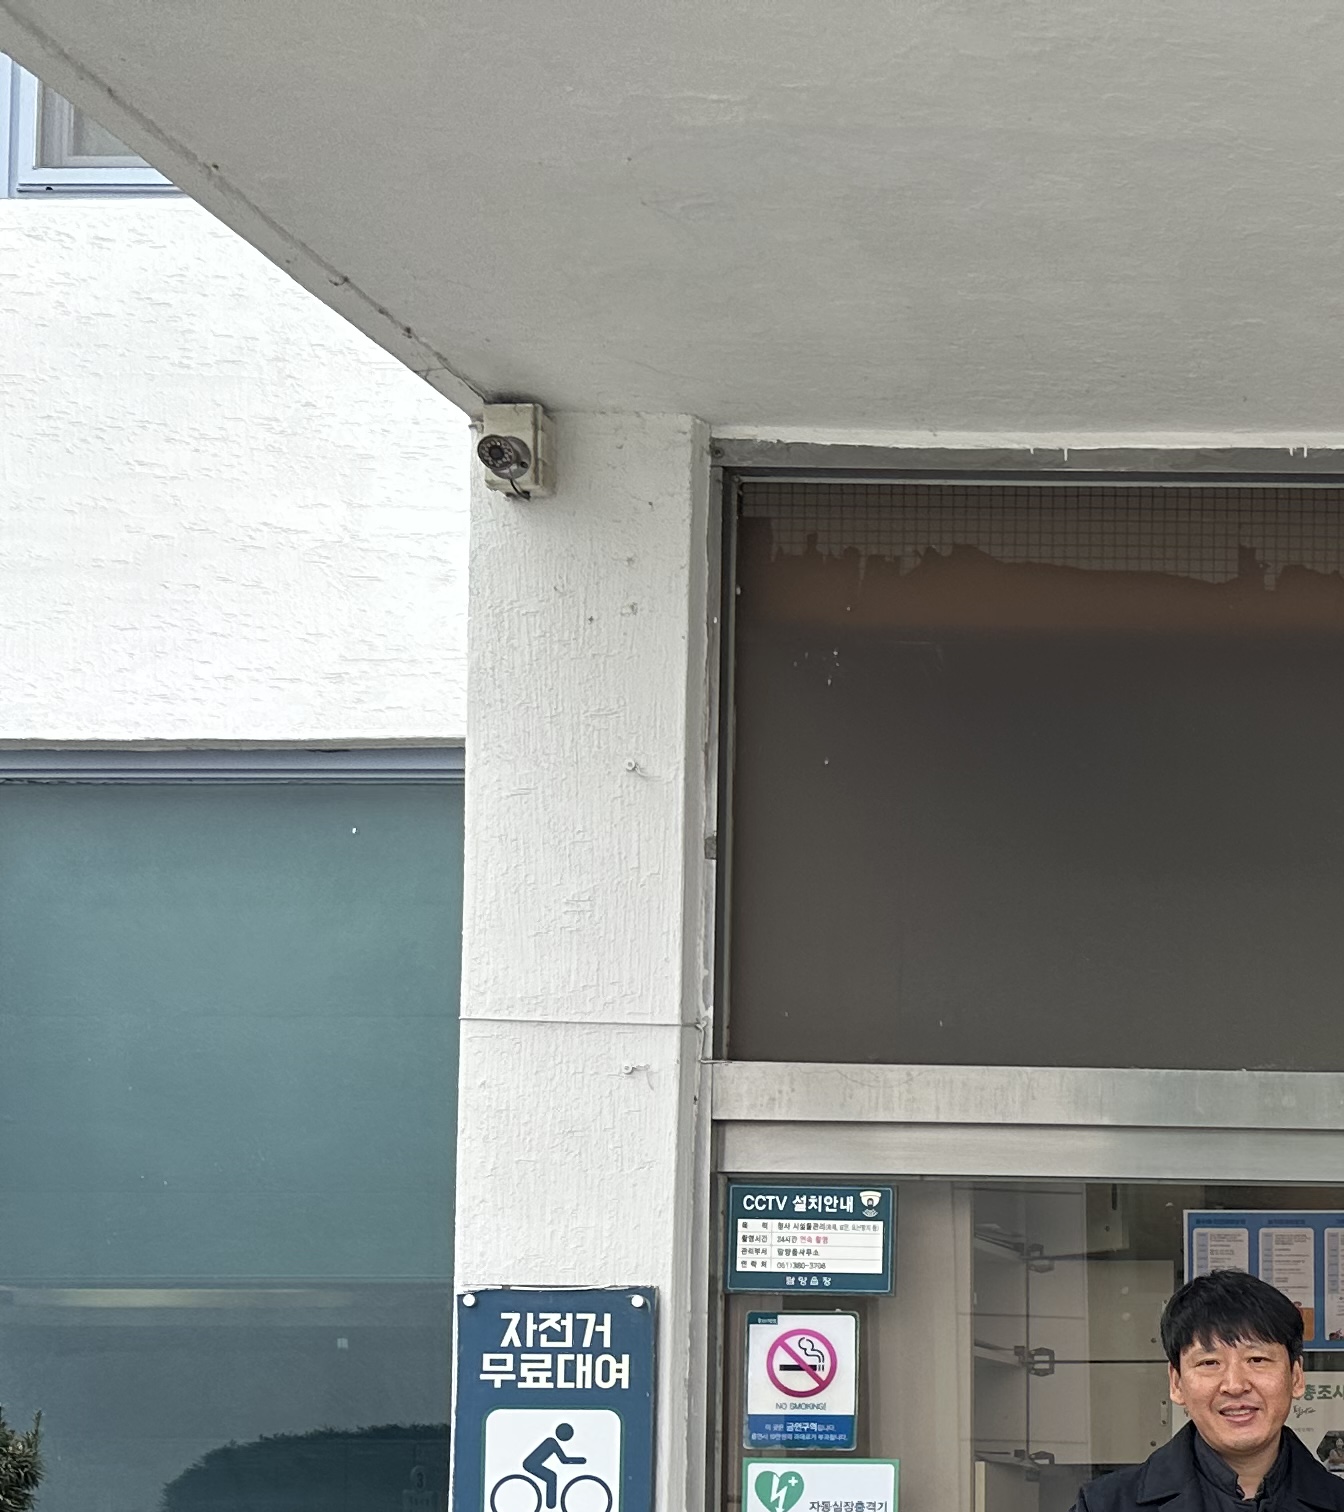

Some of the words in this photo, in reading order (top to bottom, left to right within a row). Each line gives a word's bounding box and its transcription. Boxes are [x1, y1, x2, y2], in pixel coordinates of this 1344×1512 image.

[743, 1194, 788, 1211] CCTV
[792, 1194, 854, 1213] 설치안내
[499, 1312, 613, 1349] 자전거
[479, 1353, 631, 1390] 무료대여
[775, 1402, 787, 1411] NO
[809, 1501, 888, 1512] 자동심장충격기
